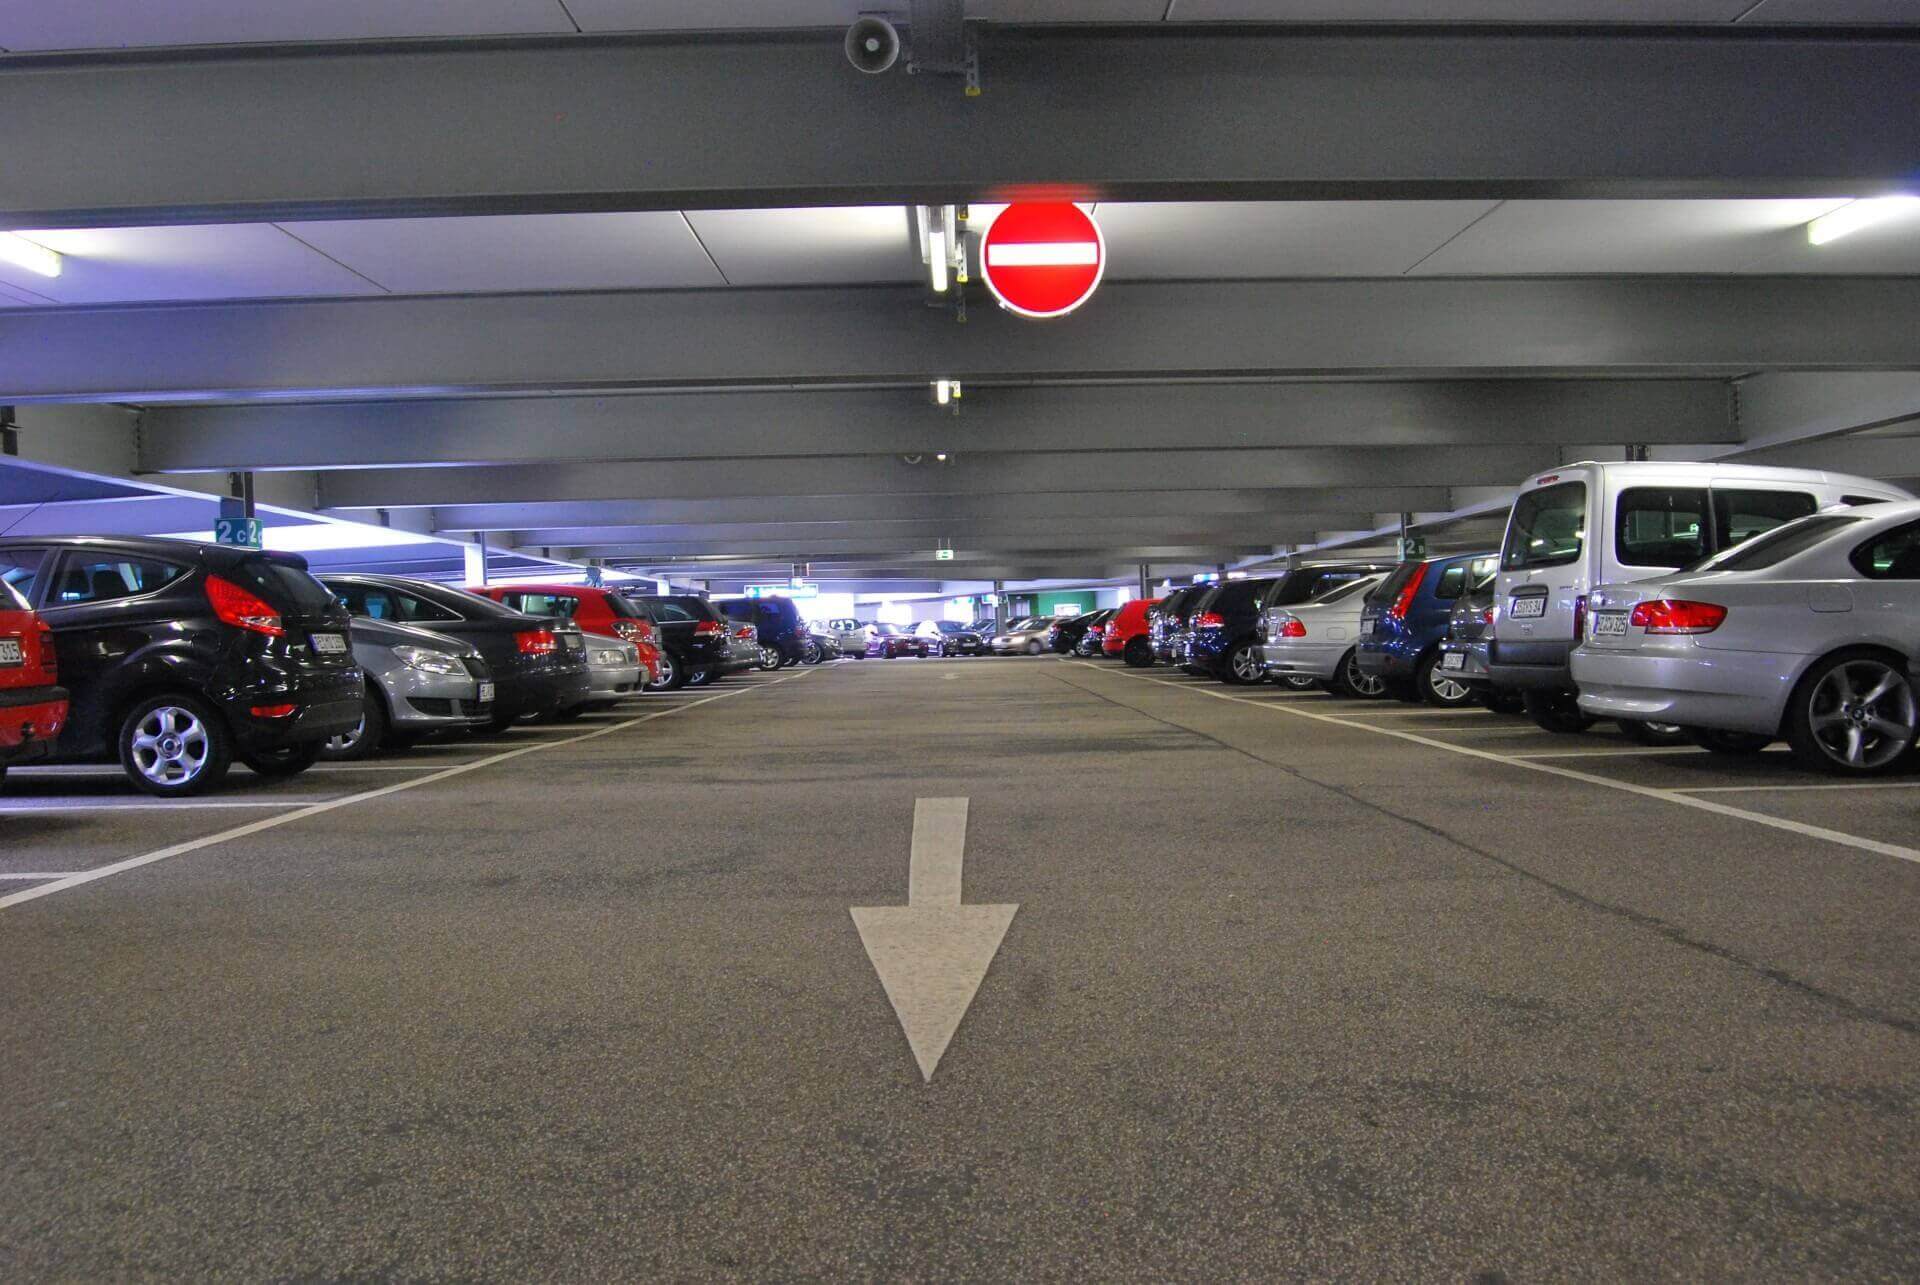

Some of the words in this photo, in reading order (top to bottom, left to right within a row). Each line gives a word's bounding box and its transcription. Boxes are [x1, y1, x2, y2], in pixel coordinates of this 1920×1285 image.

[218, 521, 232, 543] 2
[250, 520, 257, 543] 2
[1406, 539, 1416, 554] 2
[1614, 616, 1626, 632] 325
